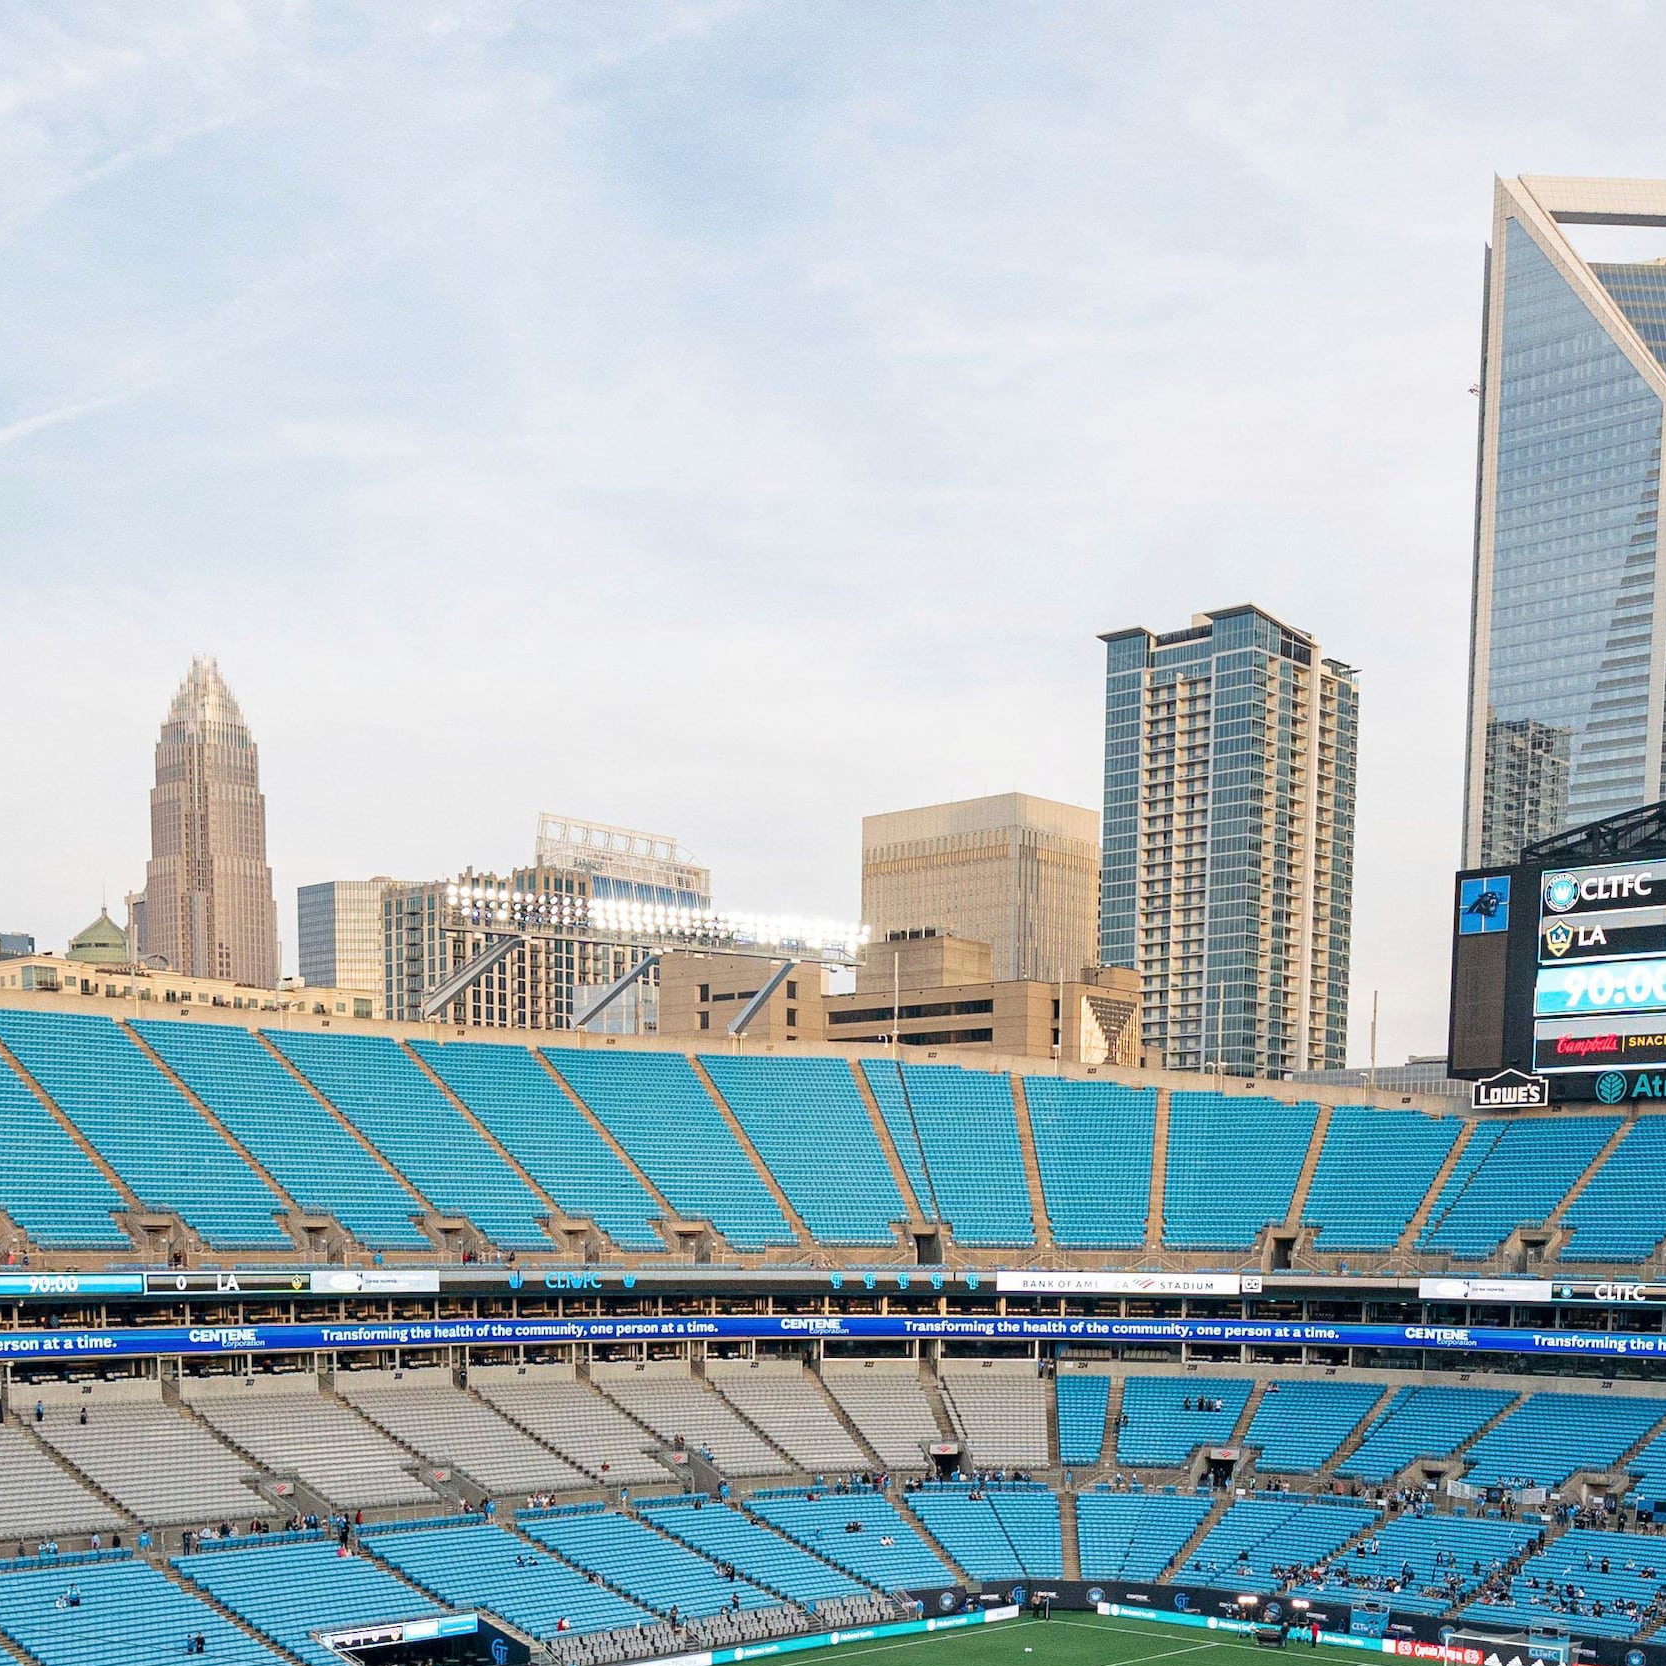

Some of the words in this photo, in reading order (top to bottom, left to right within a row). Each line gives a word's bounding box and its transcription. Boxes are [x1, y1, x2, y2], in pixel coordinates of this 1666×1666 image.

[1581, 872, 1652, 901] CLTFC
[1578, 925, 1606, 946] LA
[1479, 1083, 1541, 1105] LOWE'S
[28, 1276, 79, 1293] 90:00
[175, 1275, 187, 1290] 0
[216, 1274, 241, 1292] LA
[1023, 1280, 1054, 1288] BANK
[1058, 1280, 1073, 1288] OF
[1075, 1280, 1129, 1290] AMECA
[1160, 1281, 1215, 1290] STADIUM
[1595, 1285, 1646, 1301] CLTFC
[780, 1318, 841, 1329] CENTENE
[905, 1320, 995, 1335] Transforming
[997, 1321, 1020, 1333] the
[1023, 1320, 1066, 1333] health
[1070, 1320, 1084, 1333] of
[1086, 1321, 1109, 1333] the
[1112, 1322, 1193, 1337] community,
[1196, 1326, 1221, 1336] one
[1224, 1326, 1271, 1339] person
[1274, 1326, 1290, 1338] at
[1292, 1327, 1301, 1338] a
[1304, 1327, 1339, 1339] time.
[189, 1329, 256, 1343] CENTENE
[1405, 1327, 1469, 1340] CENTENE
[43, 1336, 61, 1350] at
[64, 1337, 74, 1348] a
[77, 1335, 118, 1349] time.
[1533, 1335, 1626, 1353] Transforming
[1629, 1337, 1653, 1350] the
